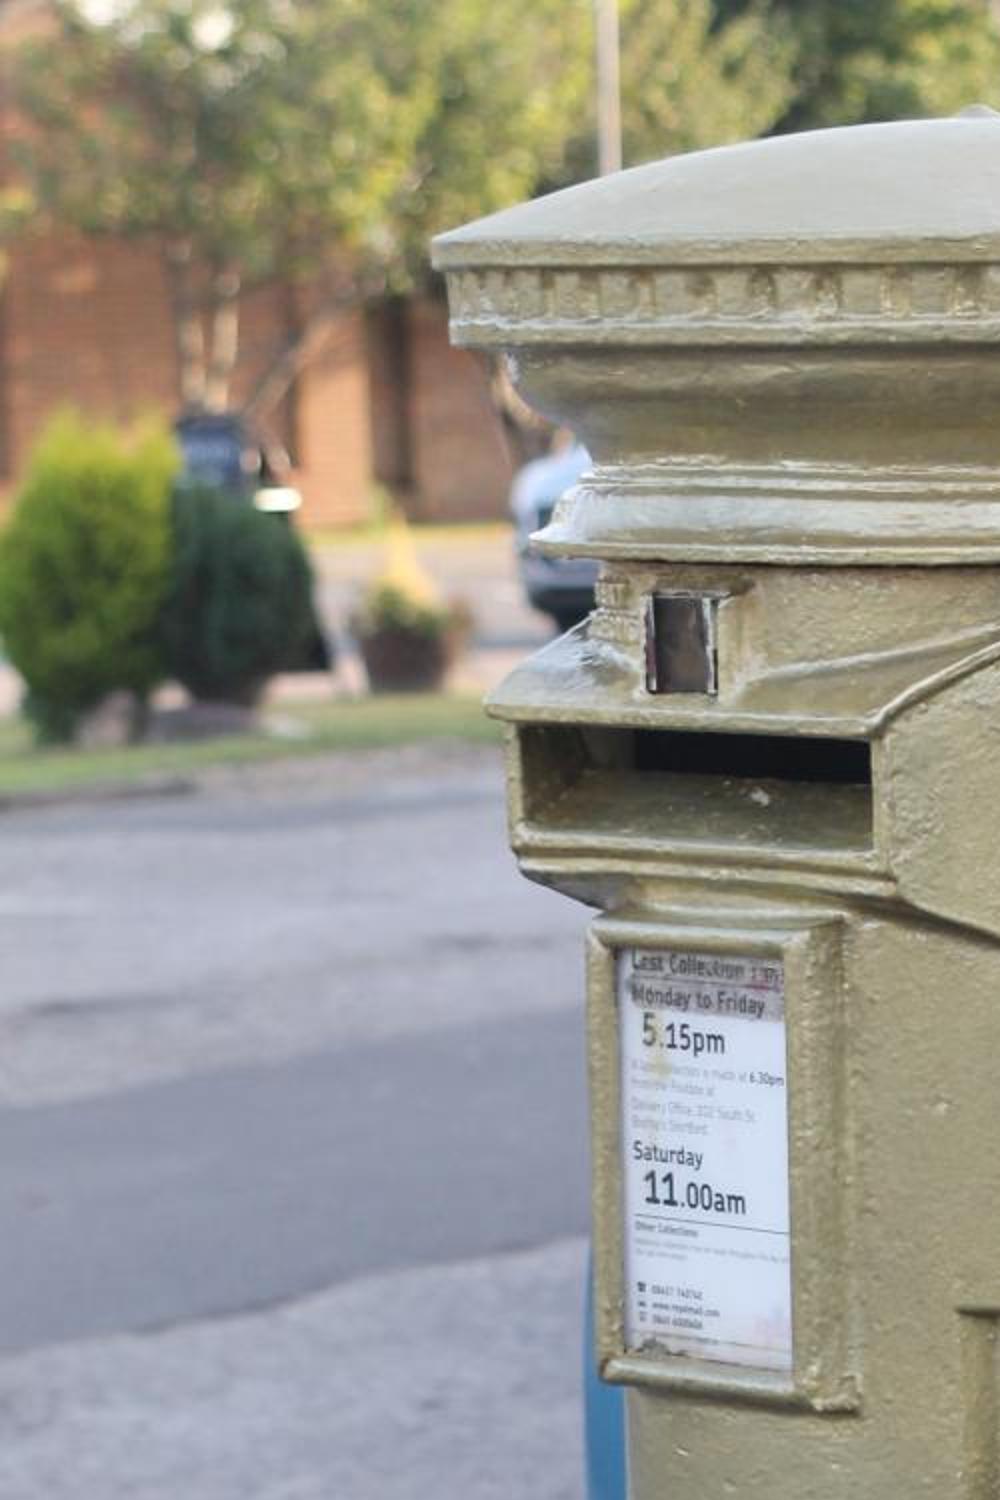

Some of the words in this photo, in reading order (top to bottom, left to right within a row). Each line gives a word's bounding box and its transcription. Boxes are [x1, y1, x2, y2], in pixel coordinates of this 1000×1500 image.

[630, 983, 691, 1012] Monday
[696, 991, 710, 1010] to
[717, 991, 765, 1018] Friday
[642, 1012, 725, 1057] 5.15pm
[633, 1140, 703, 1170] Saturday
[644, 1169, 746, 1215] 11.00am
